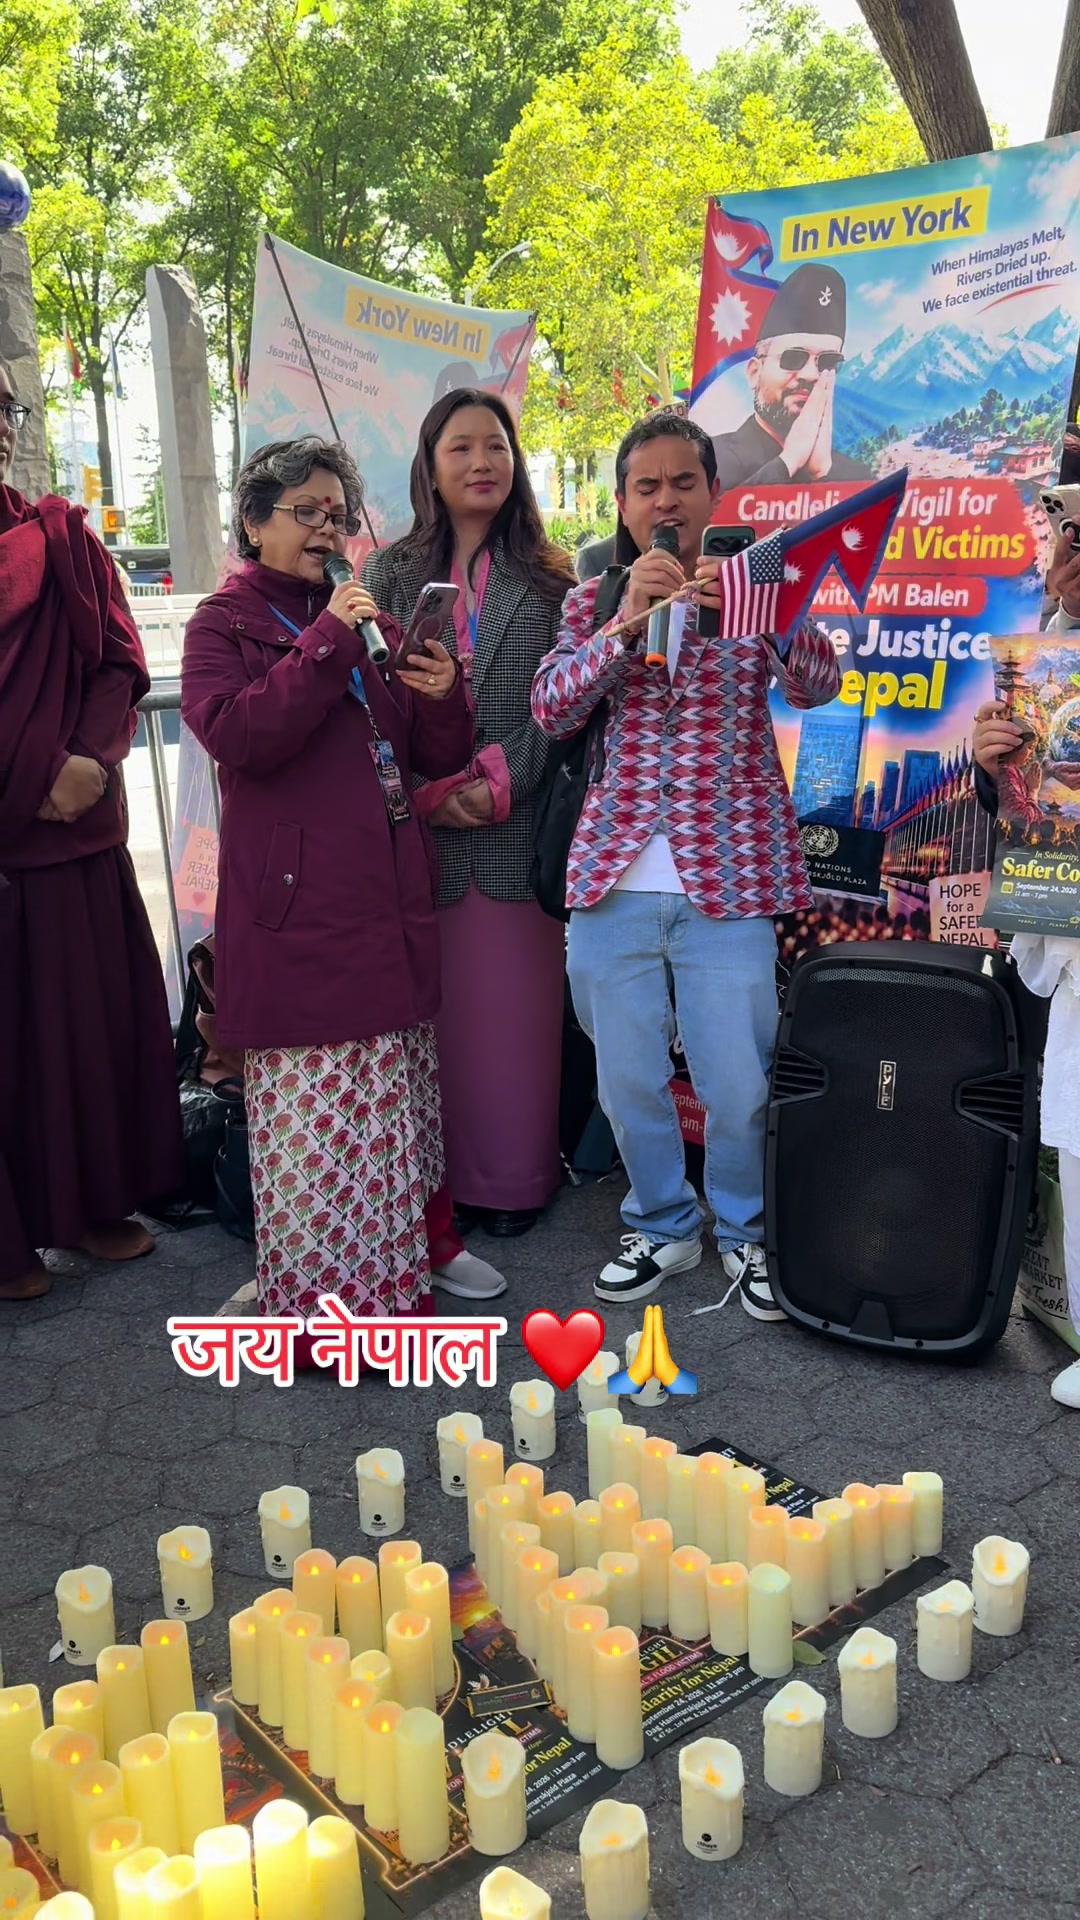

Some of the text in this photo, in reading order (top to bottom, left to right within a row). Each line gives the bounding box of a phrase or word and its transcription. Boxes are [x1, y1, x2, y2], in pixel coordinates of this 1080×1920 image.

[792, 196, 972, 252] In New York
[931, 226, 1066, 276] When Himalayas Melt,
[956, 250, 1051, 286] Rivers Dried up.
[922, 261, 1078, 314] We face existential threat.
[738, 489, 840, 521] Candleli
[958, 486, 998, 516] for
[913, 524, 1026, 560] Victims
[867, 583, 899, 606] PM
[905, 582, 969, 607] Balen
[856, 617, 992, 660] Justice
[839, 660, 947, 717] epal
[815, 862, 852, 873] NATIONS
[1001, 857, 1080, 882] Safer Co
[1034, 850, 1080, 863] In Solidarity,
[807, 870, 867, 885] RSKJÖLD PLAZA
[940, 883, 981, 898] HOPE
[1016, 882, 1049, 892] September
[1061, 886, 1077, 894] 2026
[947, 901, 974, 913] for a
[939, 932, 989, 946] NEPAL
[669, 1088, 708, 1112] eptem
[639, 1646, 683, 1671] GIL
[641, 1656, 740, 1714] darity for Nepal
[645, 1725, 661, 1738] Dag
[704, 1690, 725, 1704] Plaza
[447, 1711, 513, 1750] DLELIGHT
[519, 1727, 542, 1743] CTIMS
[534, 1736, 572, 1764] Nepal
[526, 1772, 577, 1811] marskjold Plaza
[533, 1774, 551, 1789] 2026
